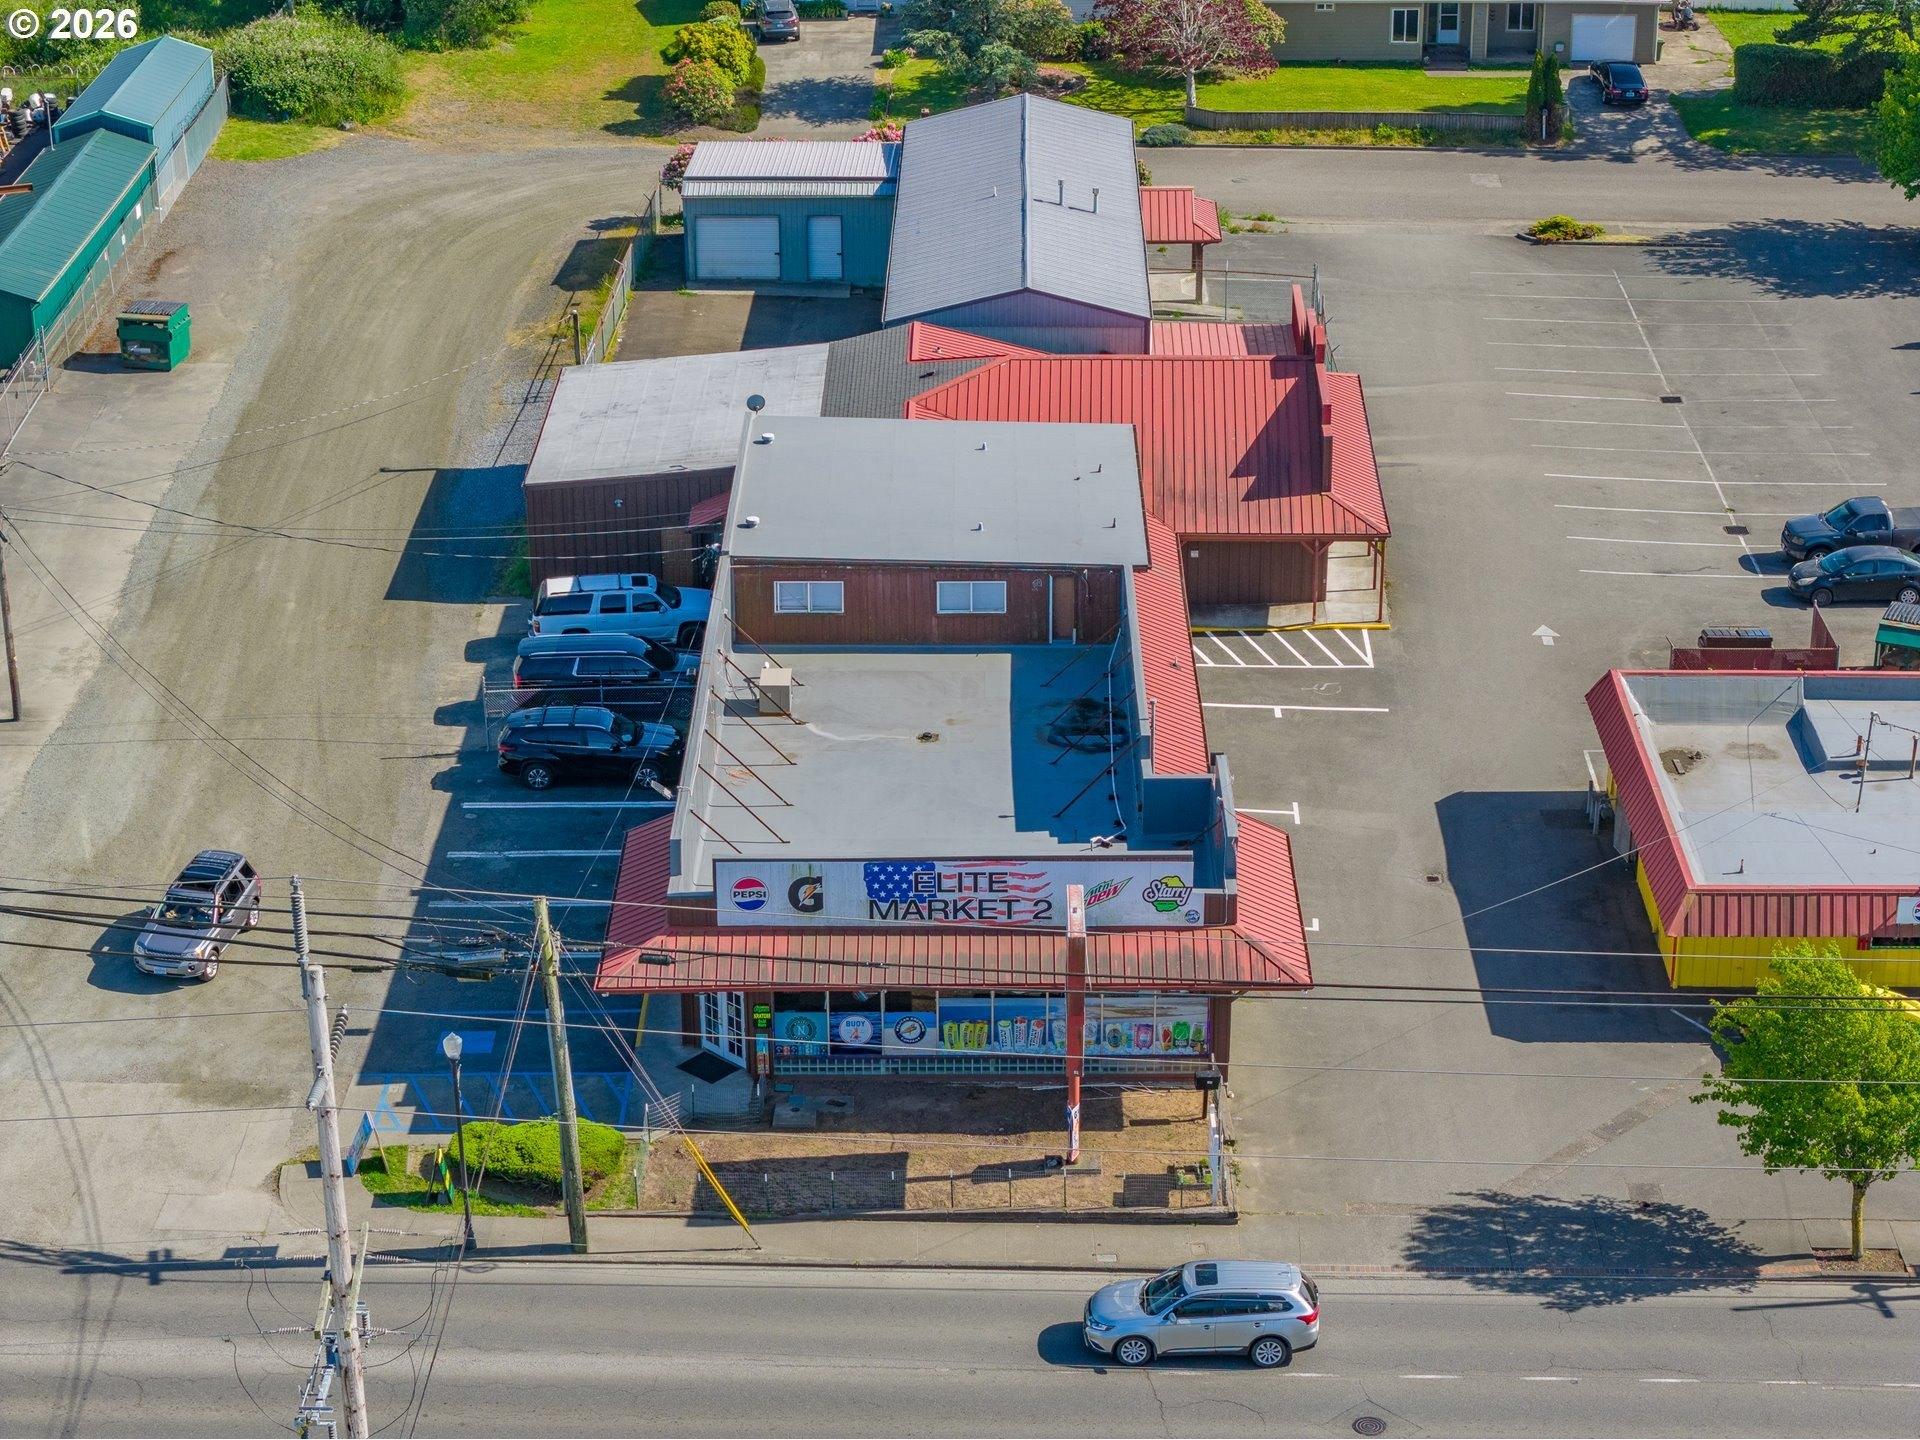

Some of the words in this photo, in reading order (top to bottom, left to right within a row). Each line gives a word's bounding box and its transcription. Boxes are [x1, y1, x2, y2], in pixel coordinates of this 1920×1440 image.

[913, 871, 1009, 893] ELITE
[733, 890, 767, 899] PEPSI
[787, 875, 824, 913] G
[1142, 879, 1193, 907] Starry
[869, 899, 1021, 920] MARKET
[1032, 899, 1053, 920] 2
[845, 1020, 866, 1028] BUOY
